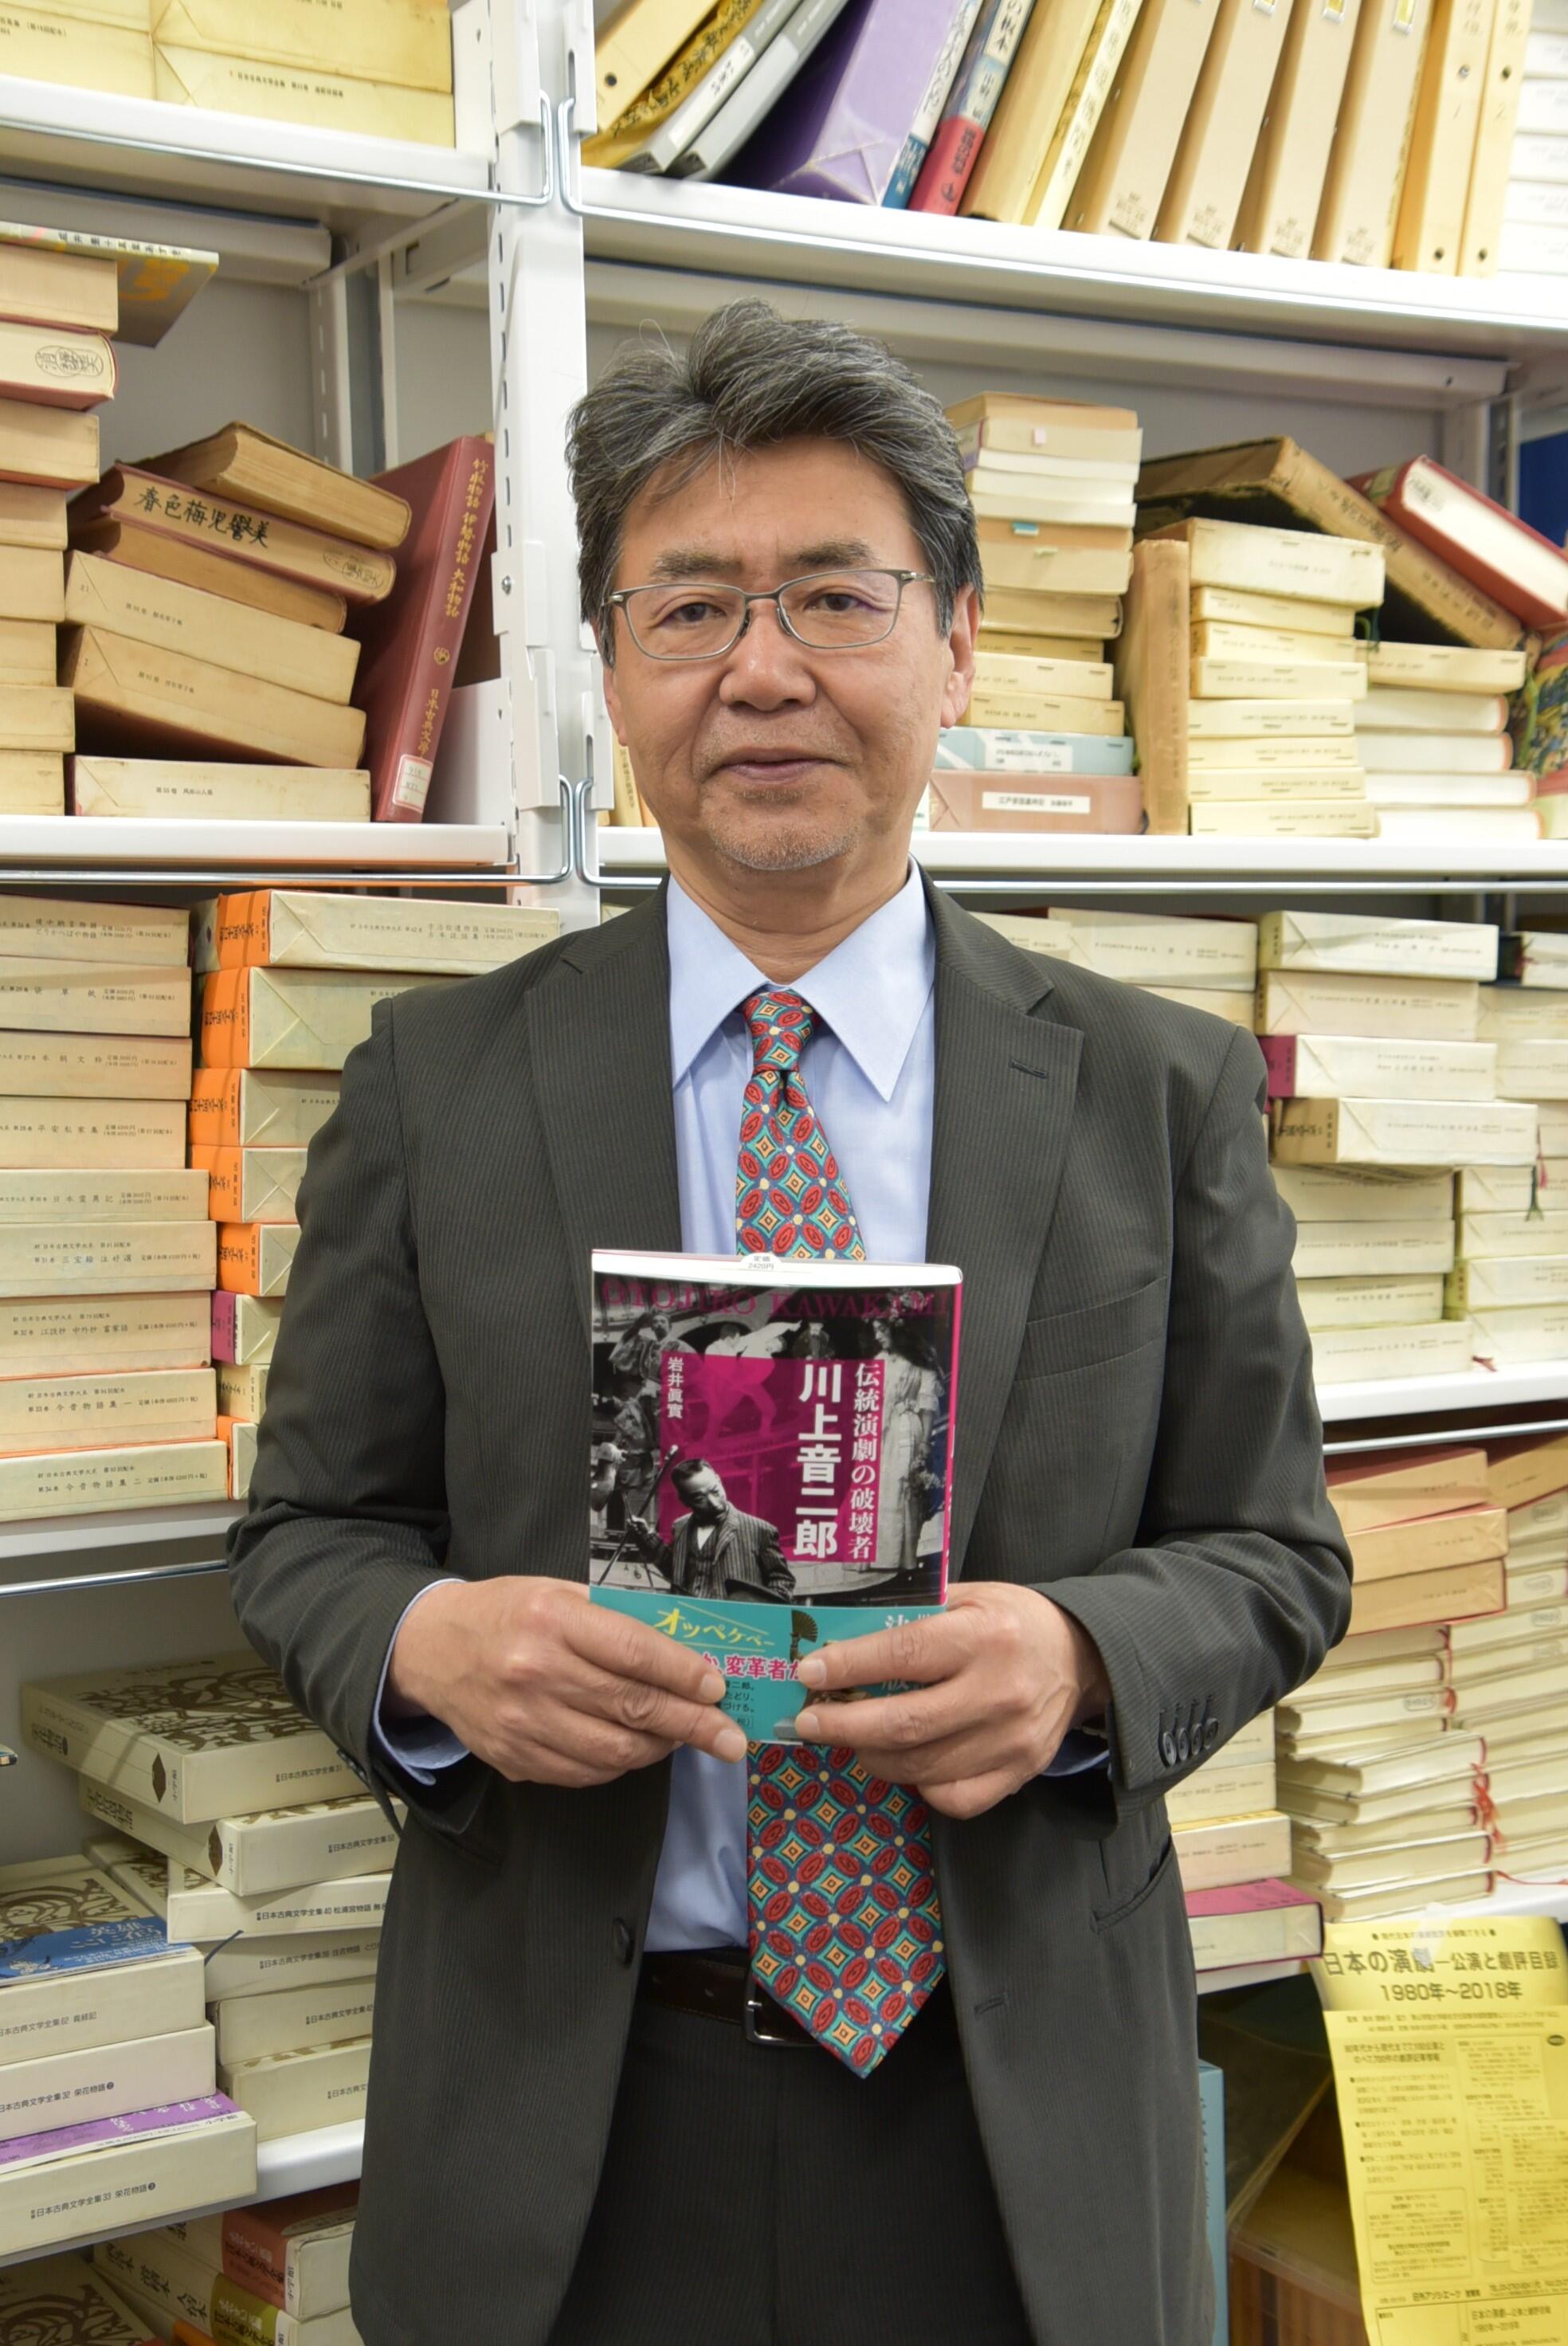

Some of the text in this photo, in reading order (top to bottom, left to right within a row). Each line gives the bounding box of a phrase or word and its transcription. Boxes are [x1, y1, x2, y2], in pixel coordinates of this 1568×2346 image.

[793, 1363, 843, 1559] 川上音二郎
[848, 1361, 882, 1561] 伝統演劇の破壊者
[654, 1607, 776, 1646] オッペケペー
